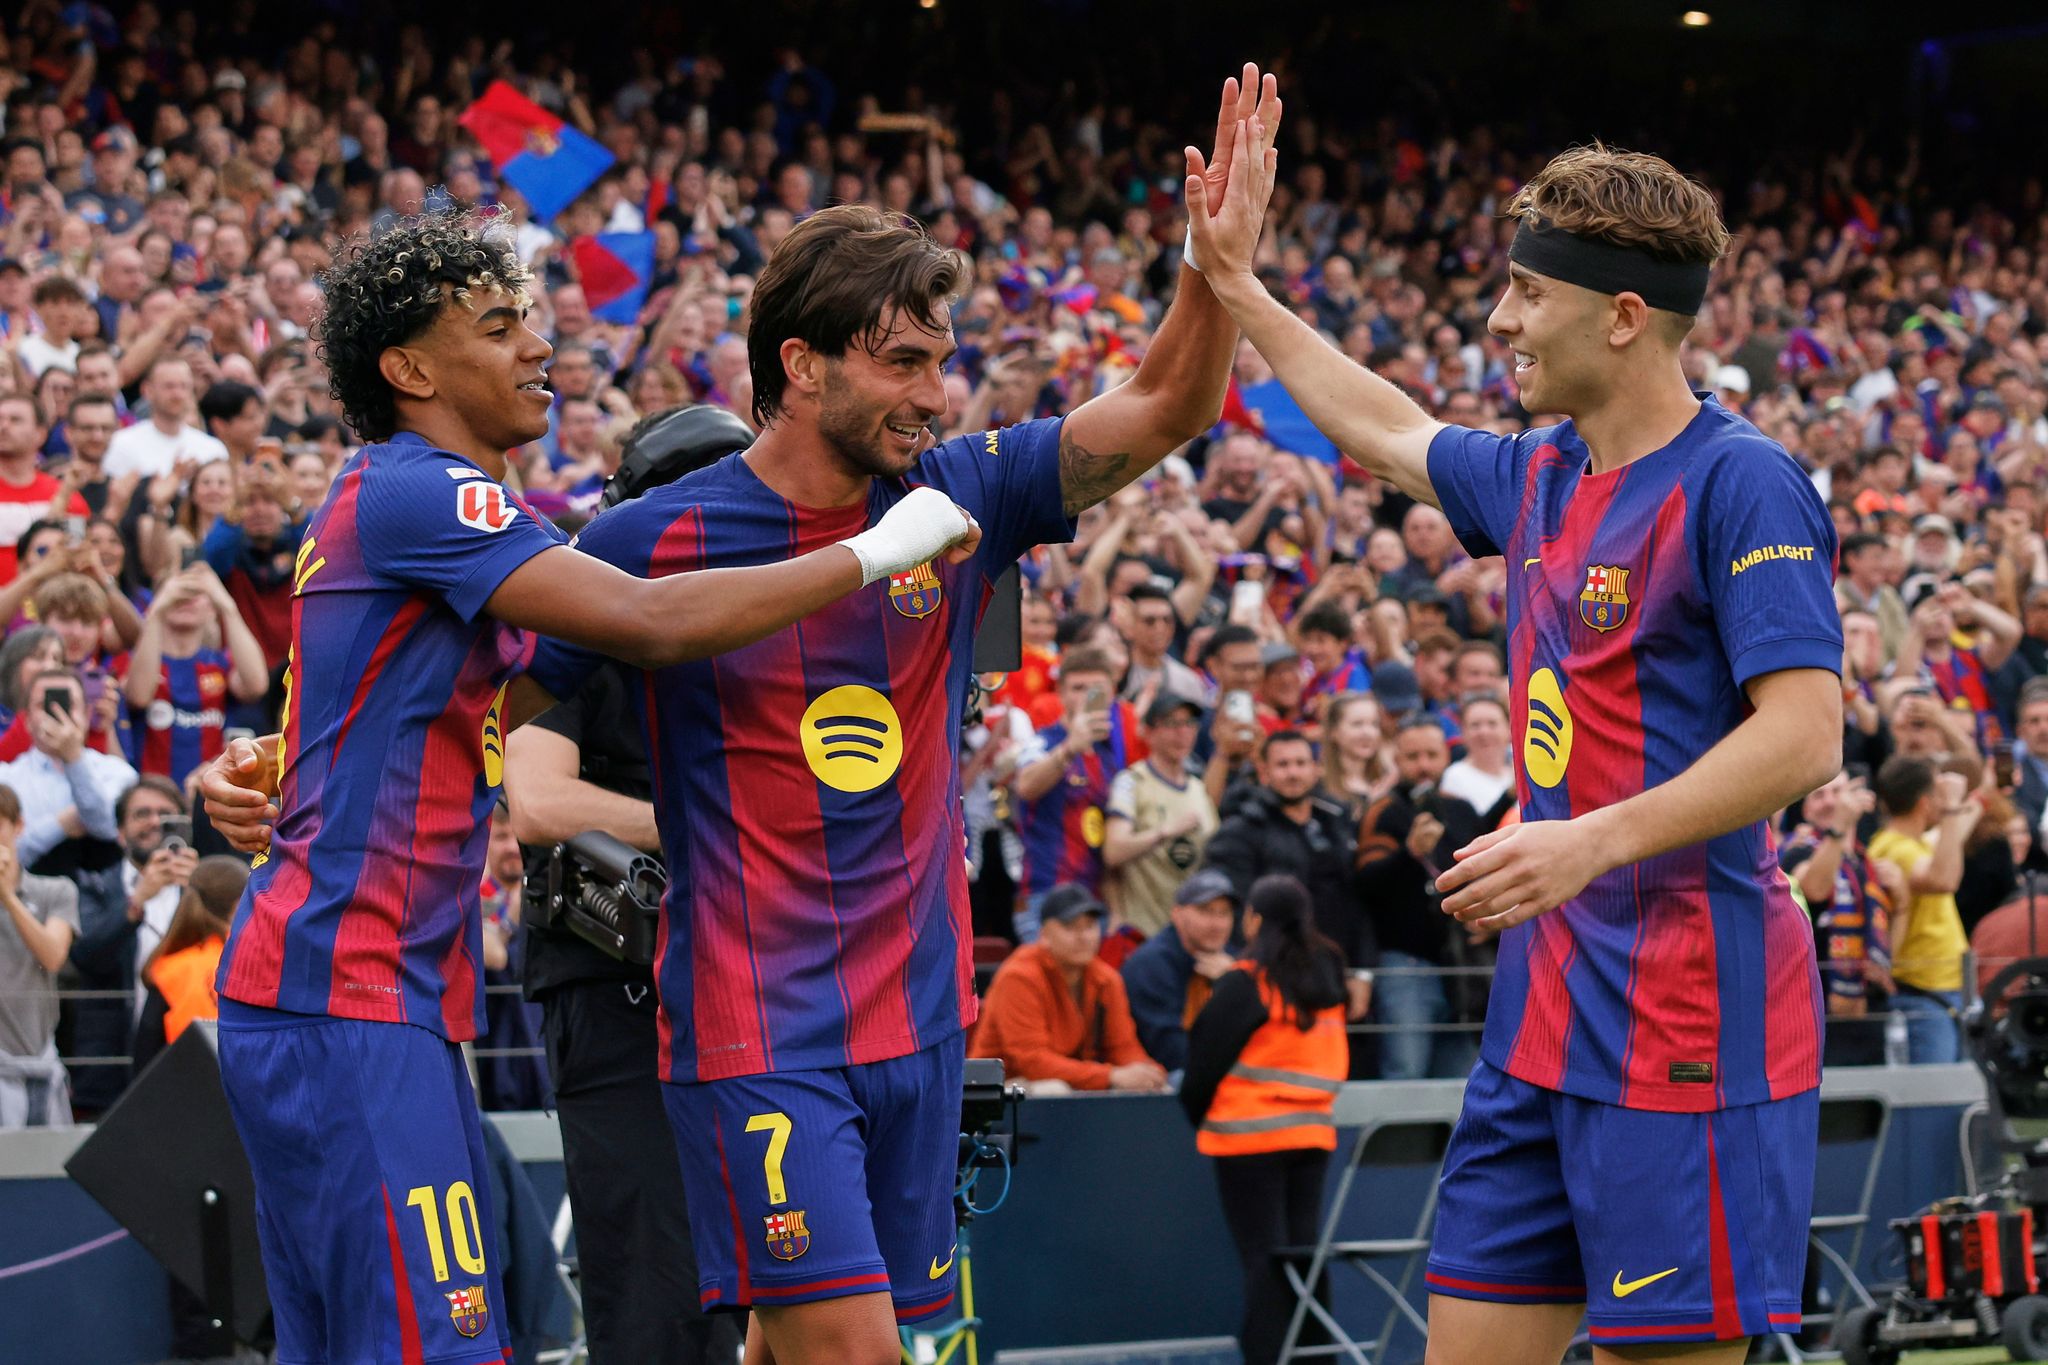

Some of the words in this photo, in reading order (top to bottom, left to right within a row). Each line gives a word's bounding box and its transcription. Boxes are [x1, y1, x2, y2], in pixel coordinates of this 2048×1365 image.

[1731, 544, 1815, 577] AMBILIGHT
[1594, 592, 1614, 602] FCB
[744, 1111, 793, 1206] 7
[406, 1180, 487, 1283] 10
[777, 1230, 796, 1241] FCB
[463, 1306, 479, 1316] FCB
